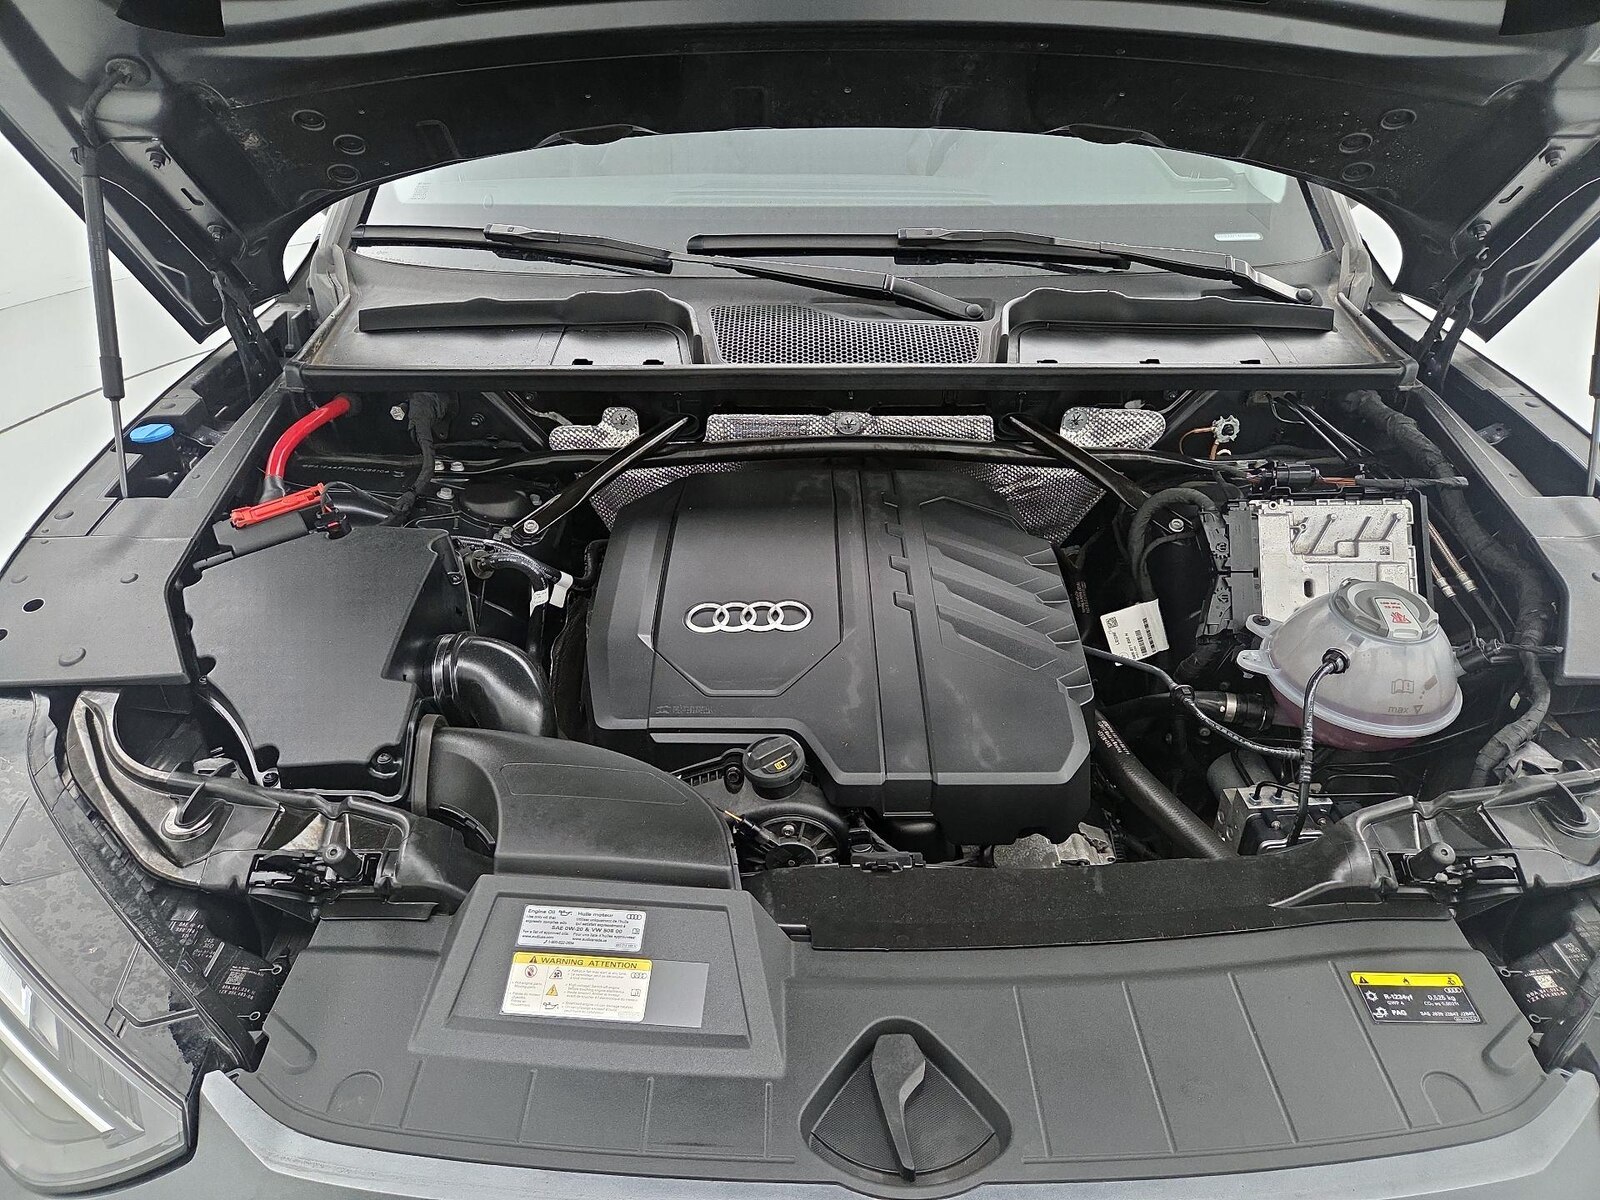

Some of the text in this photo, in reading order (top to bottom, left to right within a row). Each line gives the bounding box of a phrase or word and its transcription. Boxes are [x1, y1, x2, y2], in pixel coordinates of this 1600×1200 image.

[1387, 706, 1409, 714] max
[541, 957, 638, 969] WARNING ATTENTION
